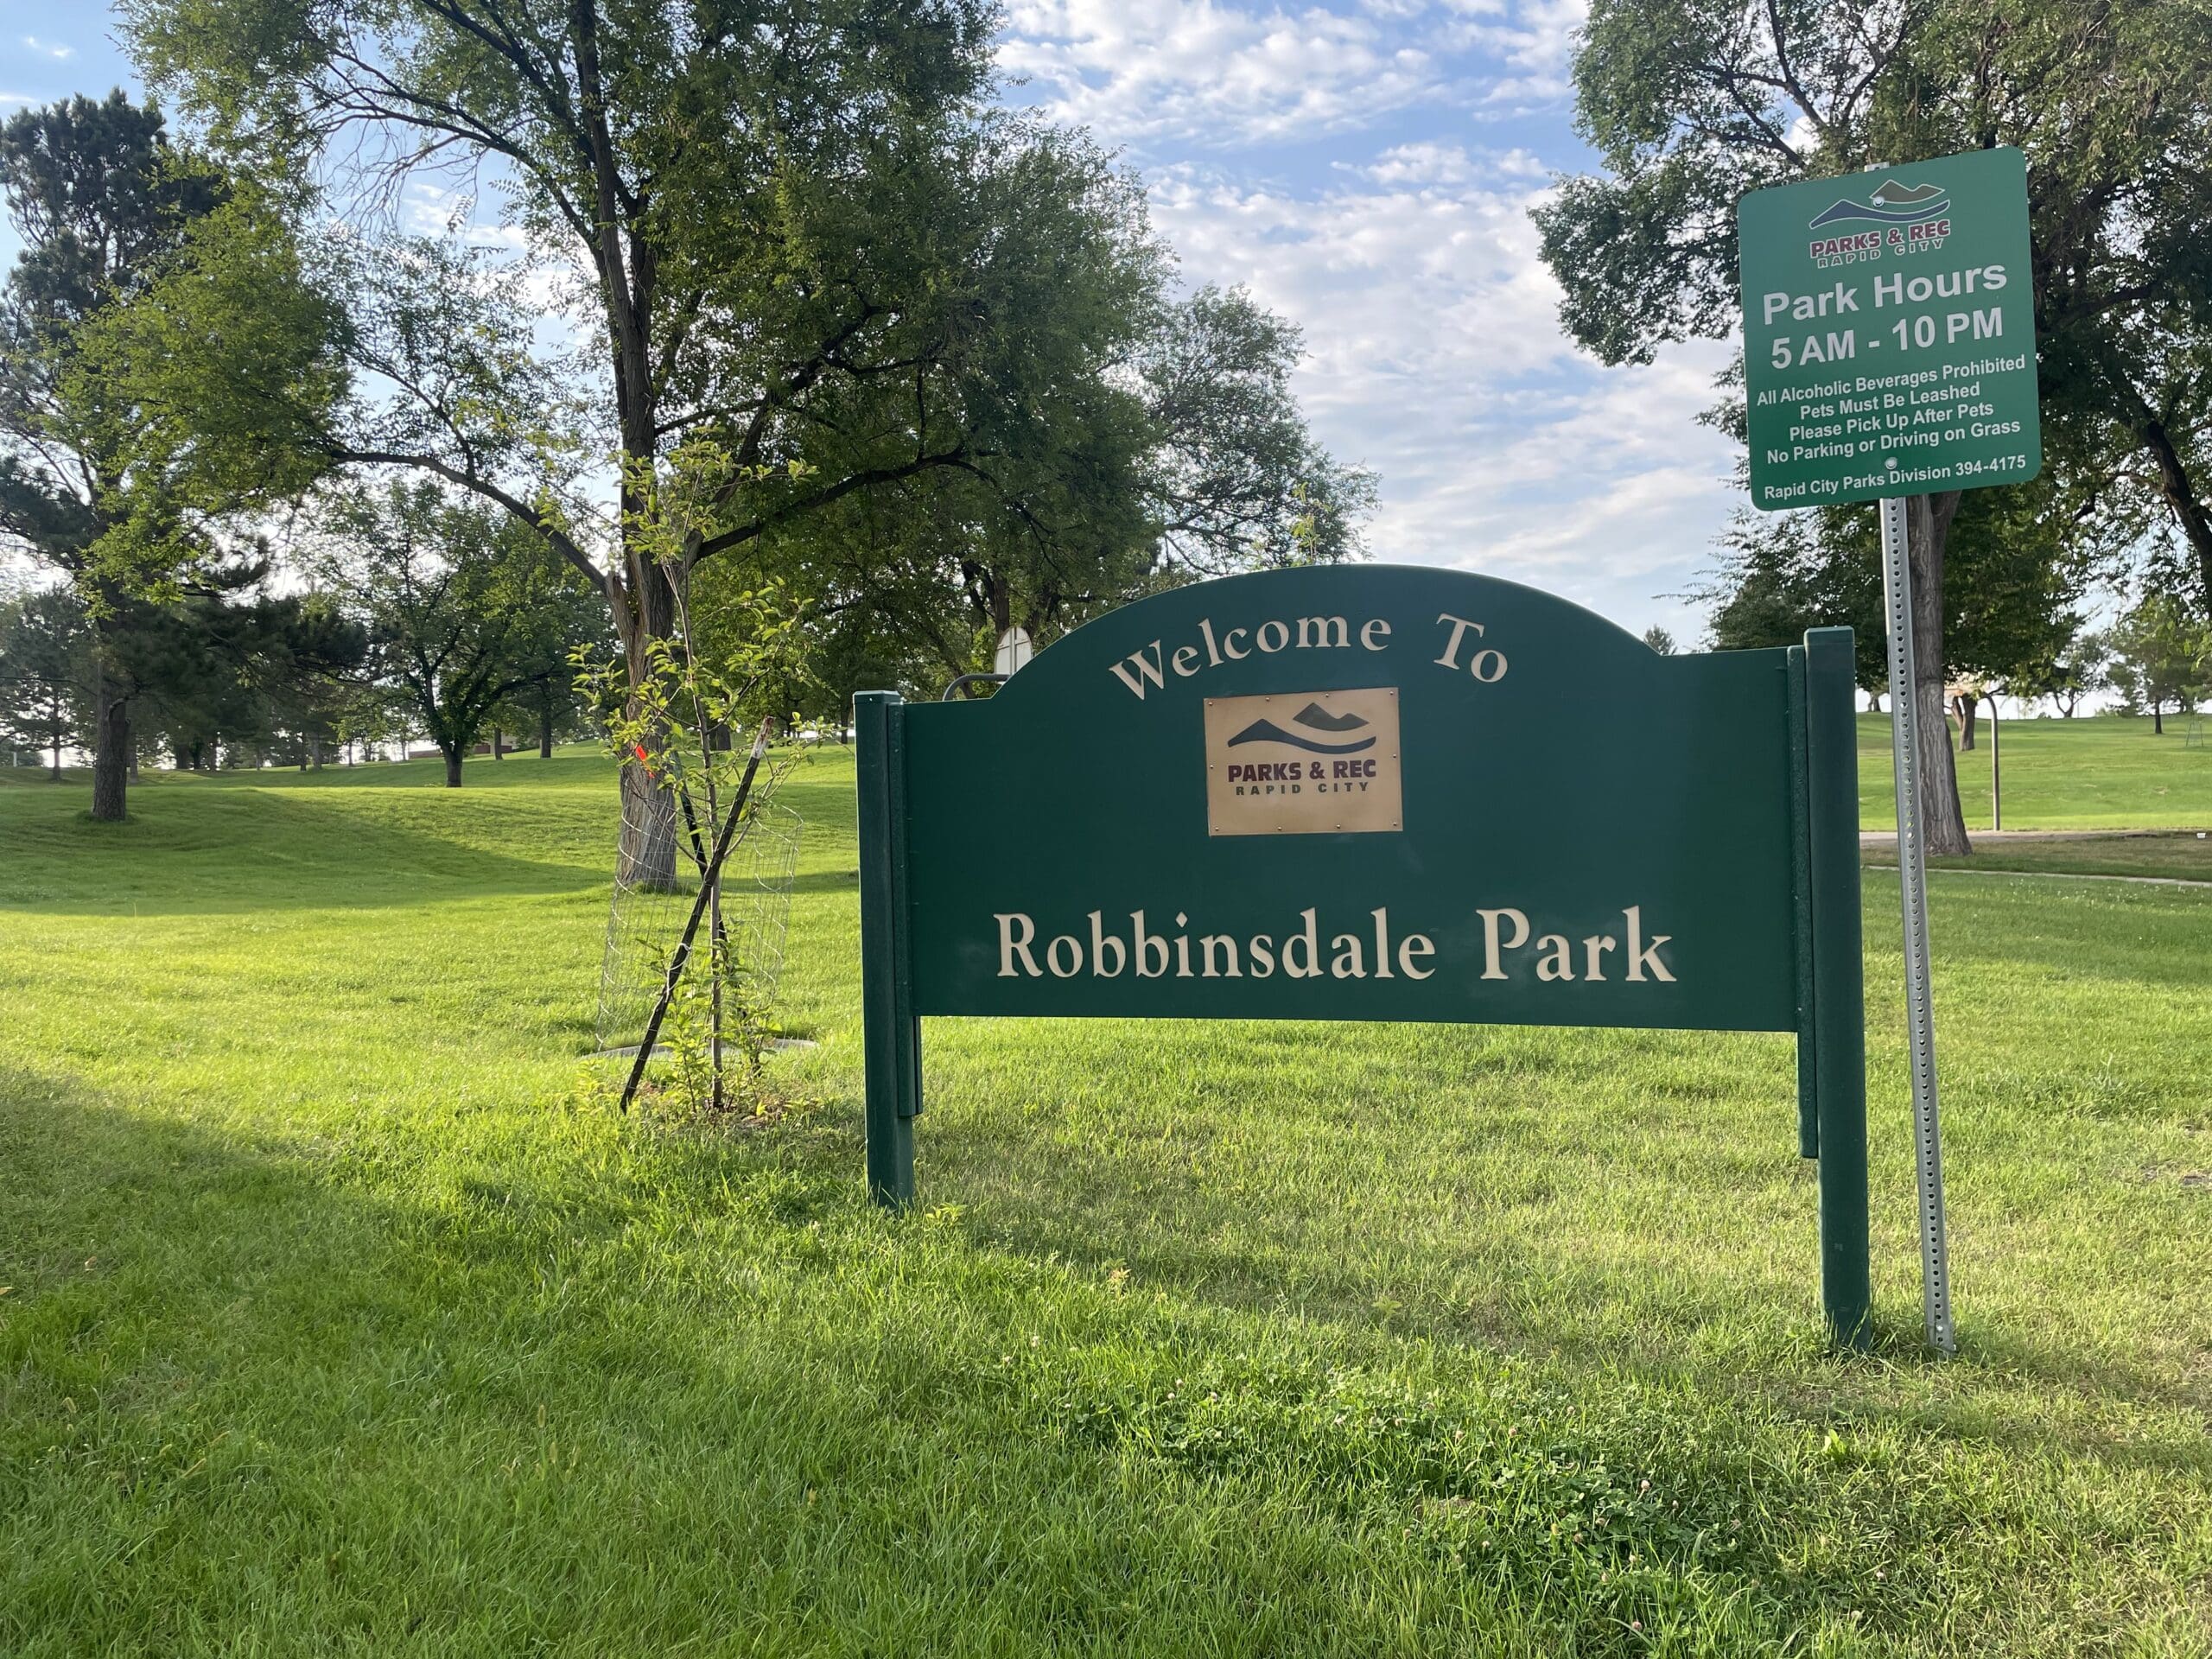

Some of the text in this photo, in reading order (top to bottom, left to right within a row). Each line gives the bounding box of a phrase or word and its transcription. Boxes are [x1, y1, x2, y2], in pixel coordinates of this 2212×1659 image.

[1810, 220, 1950, 257] PARKS & REC
[1817, 238, 1943, 269] RAPID CITY
[1764, 264, 2007, 325] Park Hours
[1771, 337, 1791, 369] 5
[1800, 330, 1855, 365] AM
[1892, 316, 1936, 351] 10
[1947, 308, 2003, 343] PM
[1758, 355, 2025, 406] All Alcoholic Beverages Prohibited
[1801, 382, 1980, 420] Pets Must Be Leashed
[1767, 420, 2020, 463] No Parking or Driving on Grass
[1789, 403, 1993, 442] Please Pick Up After Pets
[1764, 455, 2025, 499] Rapid City Parks Division 394-4175
[1109, 613, 1509, 701] Welcome To
[1228, 759, 1376, 783] PARKS & REC
[1236, 782, 1370, 795] RAPID CITY
[993, 906, 1677, 983] Robbinsdale Park
